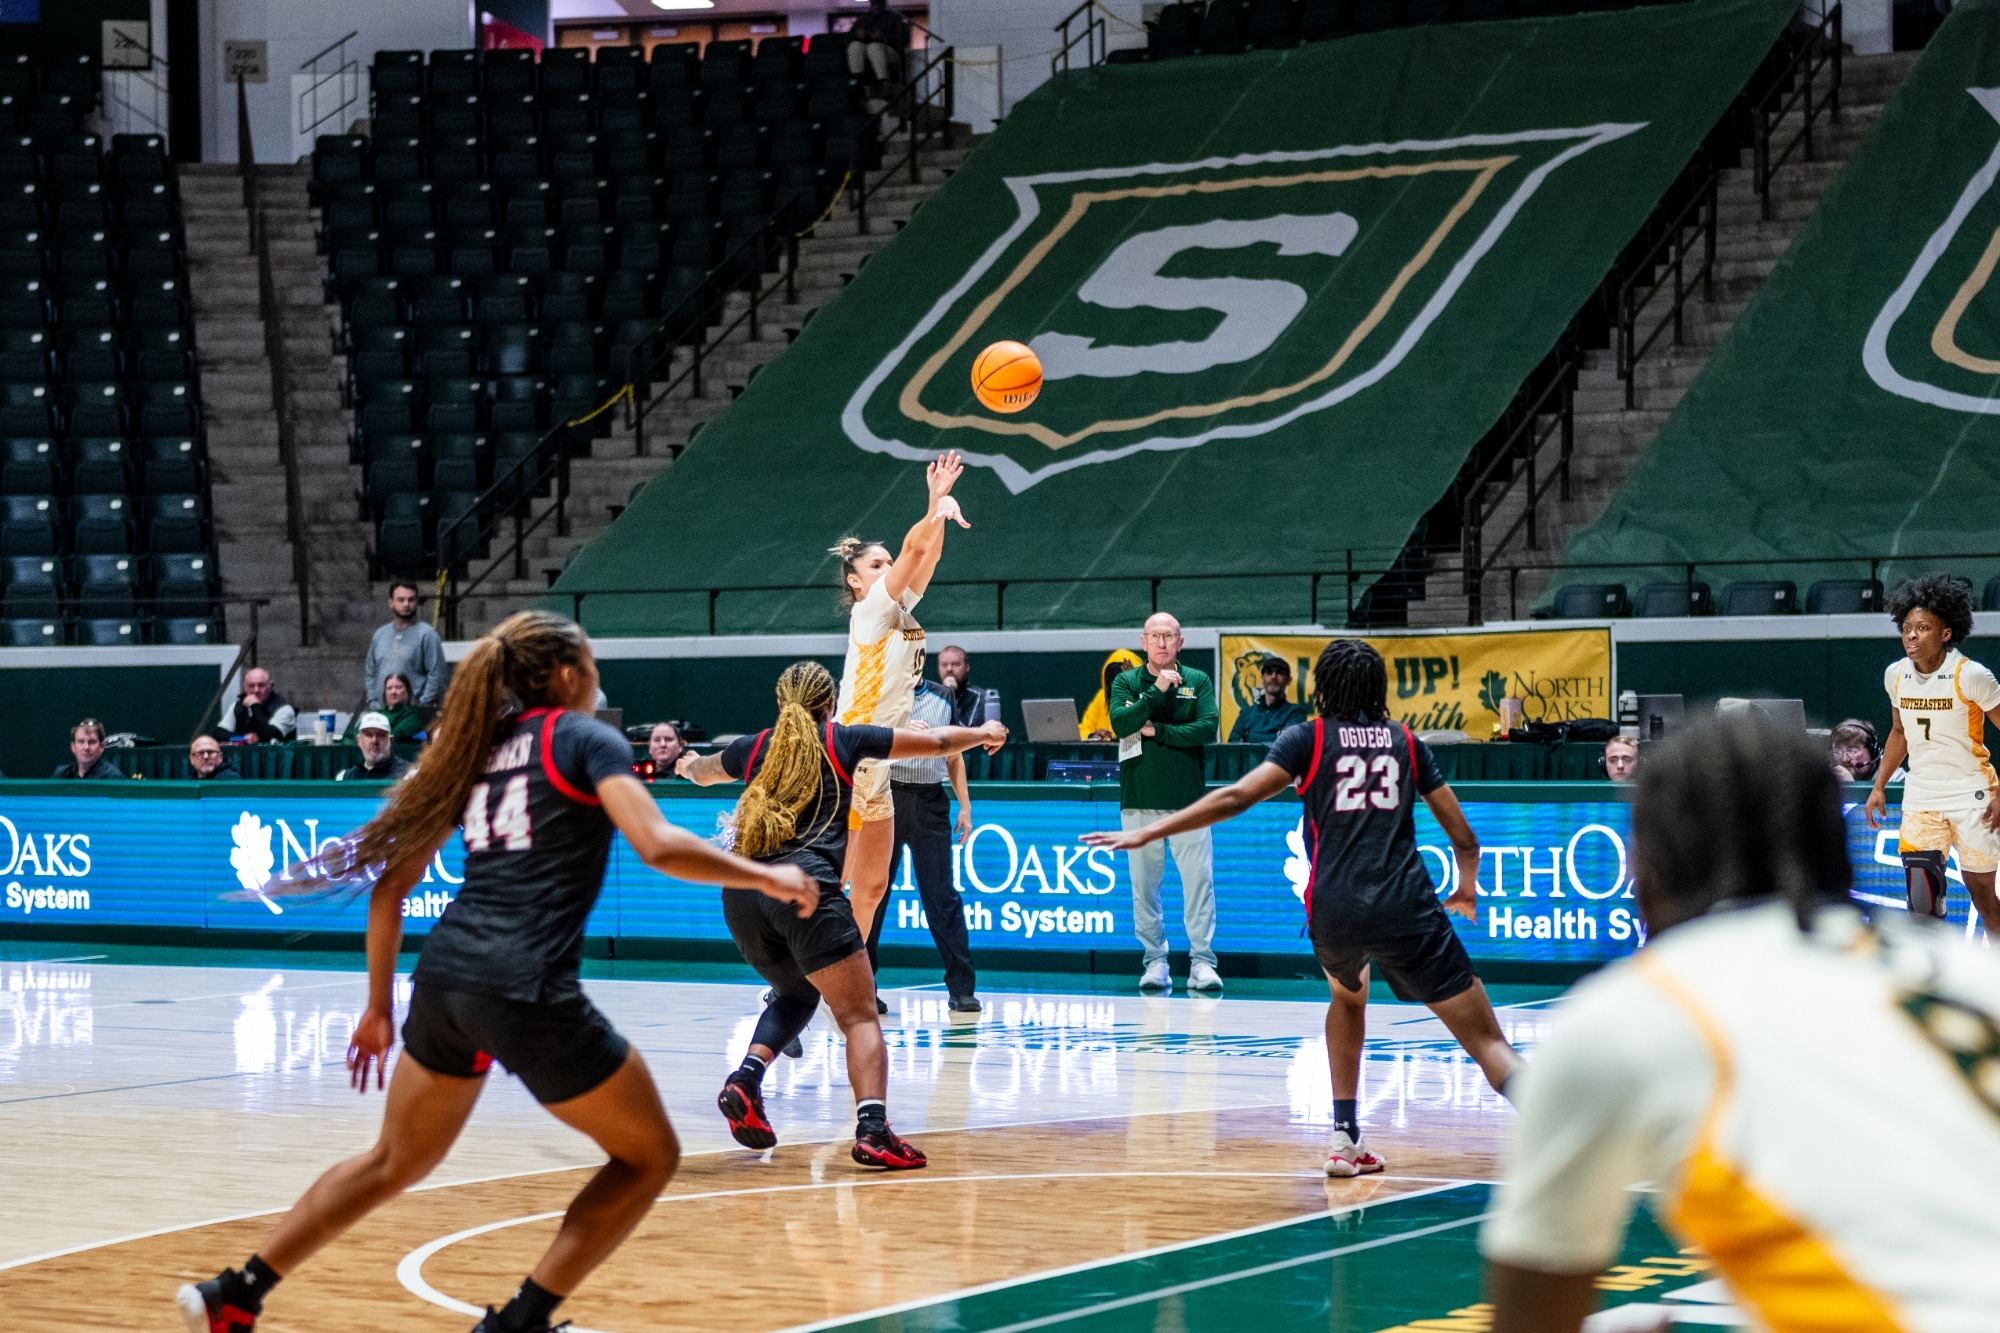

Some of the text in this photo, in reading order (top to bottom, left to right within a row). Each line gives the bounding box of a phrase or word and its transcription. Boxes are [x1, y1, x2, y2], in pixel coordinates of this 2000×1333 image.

[1028, 211, 1359, 381] S
[1394, 655, 1460, 700] UP!
[1513, 670, 1603, 699] NORTH
[1401, 701, 1468, 731] with
[1521, 694, 1593, 721] OAKS
[1900, 697, 1953, 711] SOUTHEASTERN
[1338, 726, 1393, 749] OGUEGO
[1916, 717, 1931, 741] 7
[1335, 754, 1401, 812] 23
[463, 774, 533, 851] 44
[6, 881, 90, 914] System
[1000, 901, 1114, 939] System
[1489, 906, 1597, 940] Health
